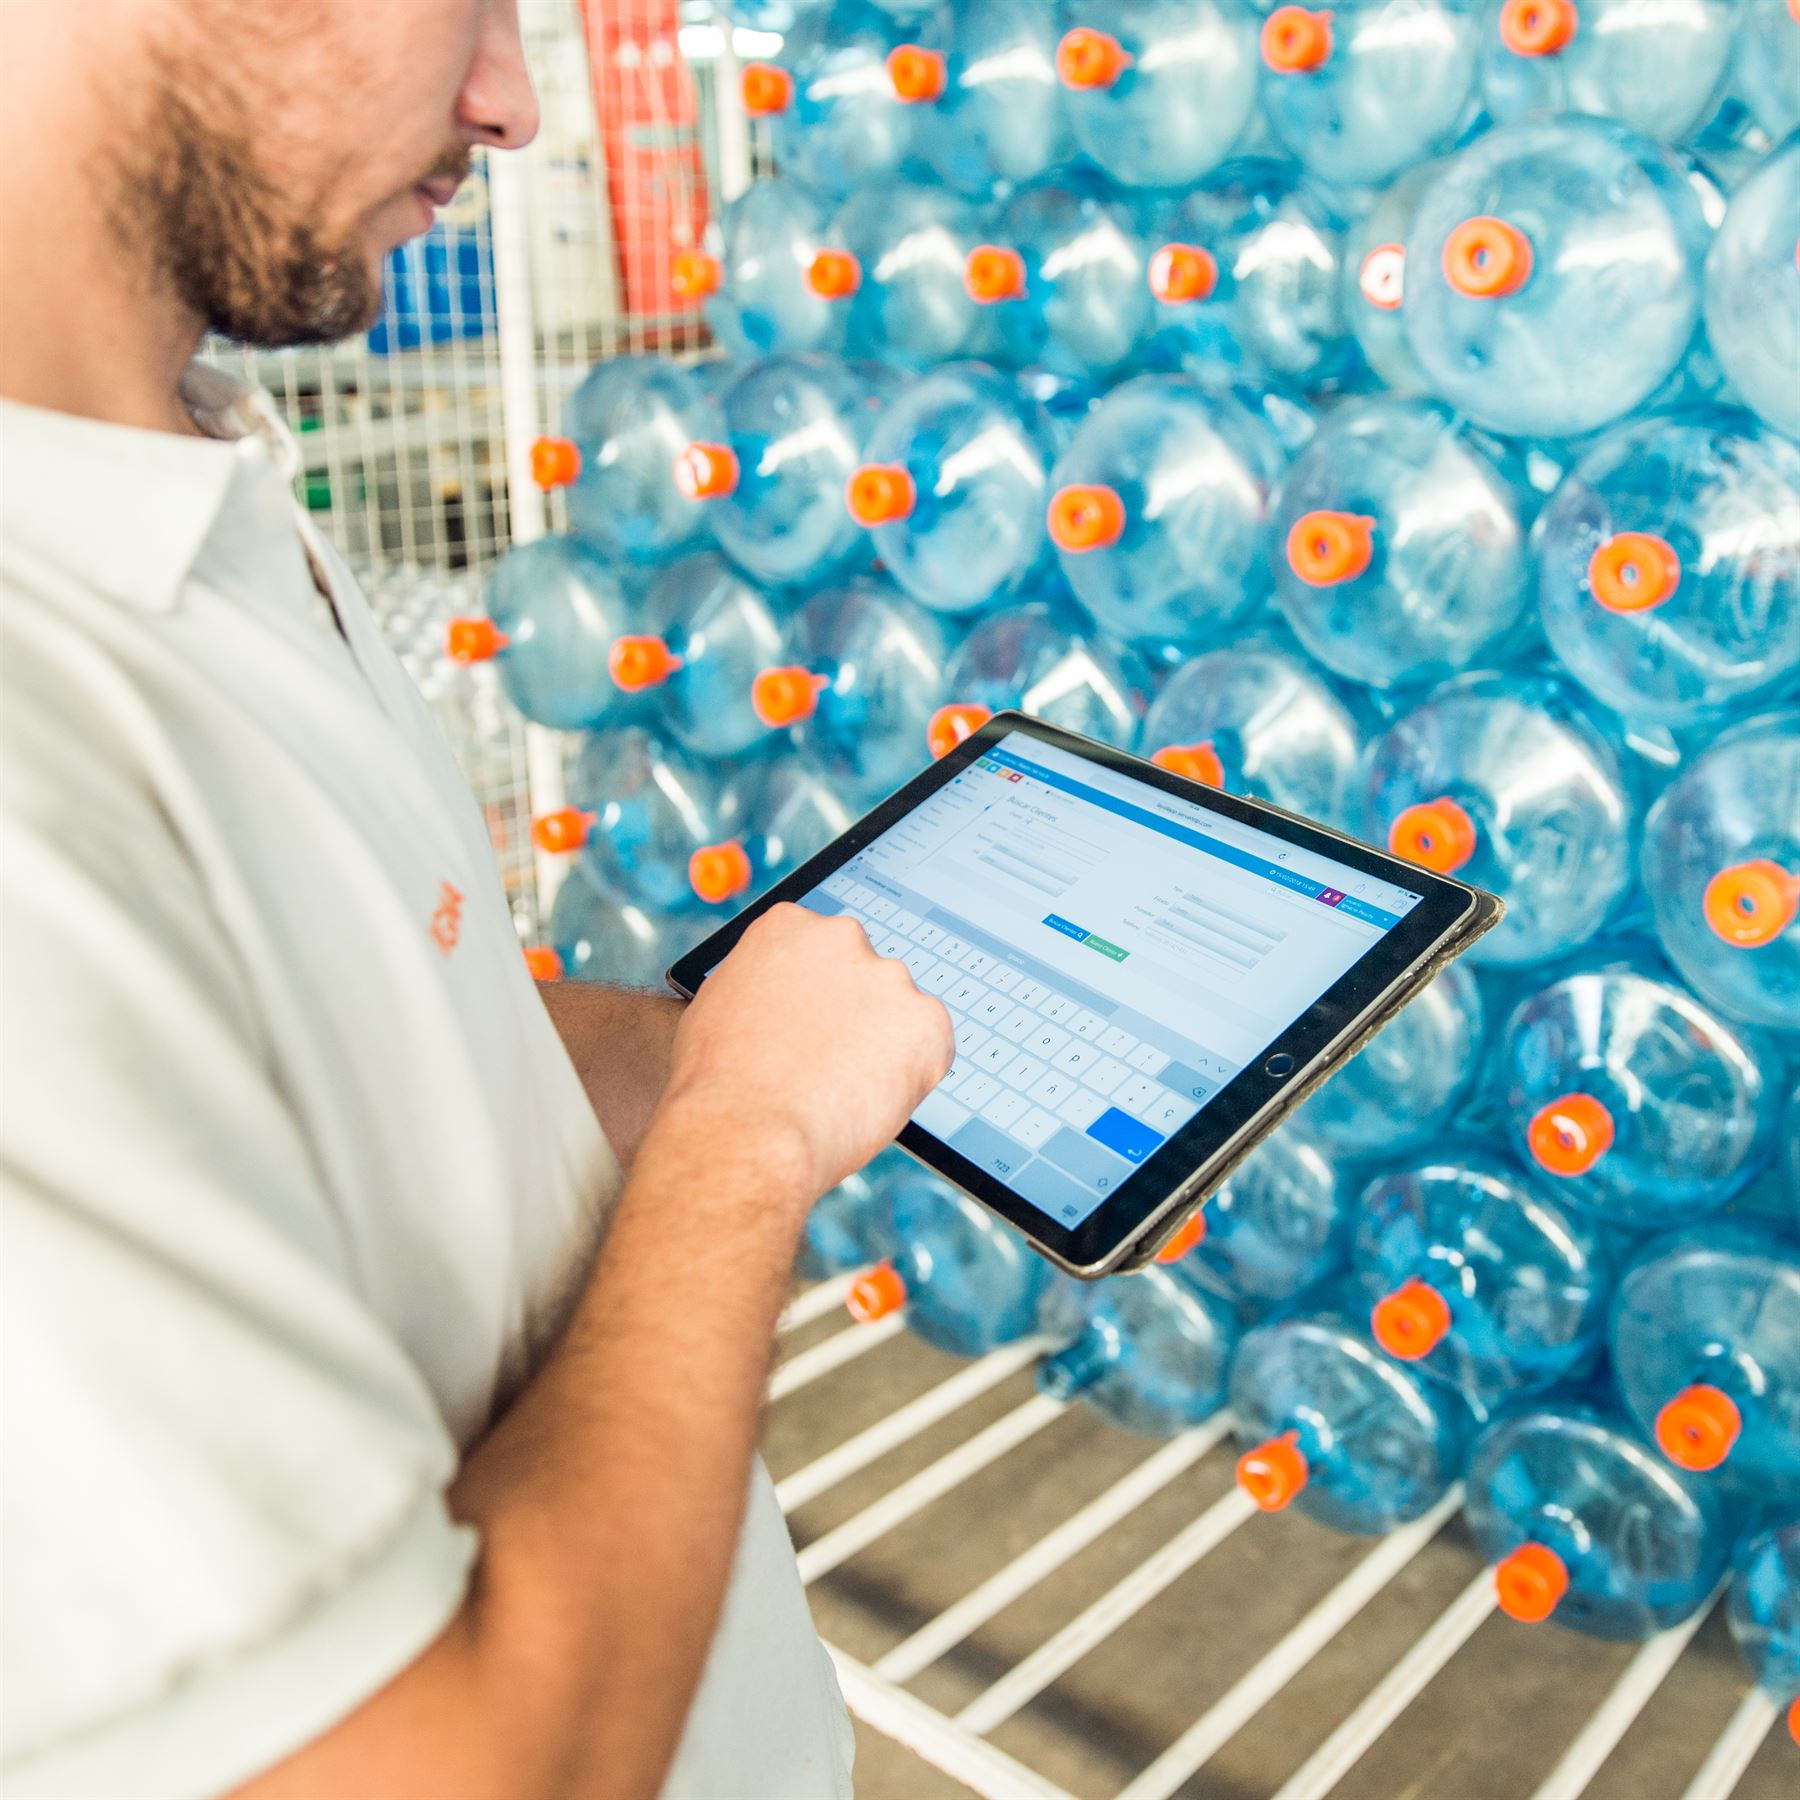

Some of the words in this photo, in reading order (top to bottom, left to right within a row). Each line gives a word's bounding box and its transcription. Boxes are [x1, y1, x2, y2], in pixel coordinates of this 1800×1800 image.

[1007, 795, 1030, 809] Buscar
[1030, 806, 1057, 822] Clientes
[937, 974, 944, 982] t
[959, 989, 970, 998] y
[987, 1005, 996, 1013] u
[1016, 1019, 1024, 1028] i
[1043, 1037, 1051, 1045] o
[1069, 1054, 1081, 1063] p
[962, 1033, 973, 1044] j
[991, 1049, 999, 1059] k
[1047, 1084, 1058, 1094] ñ
